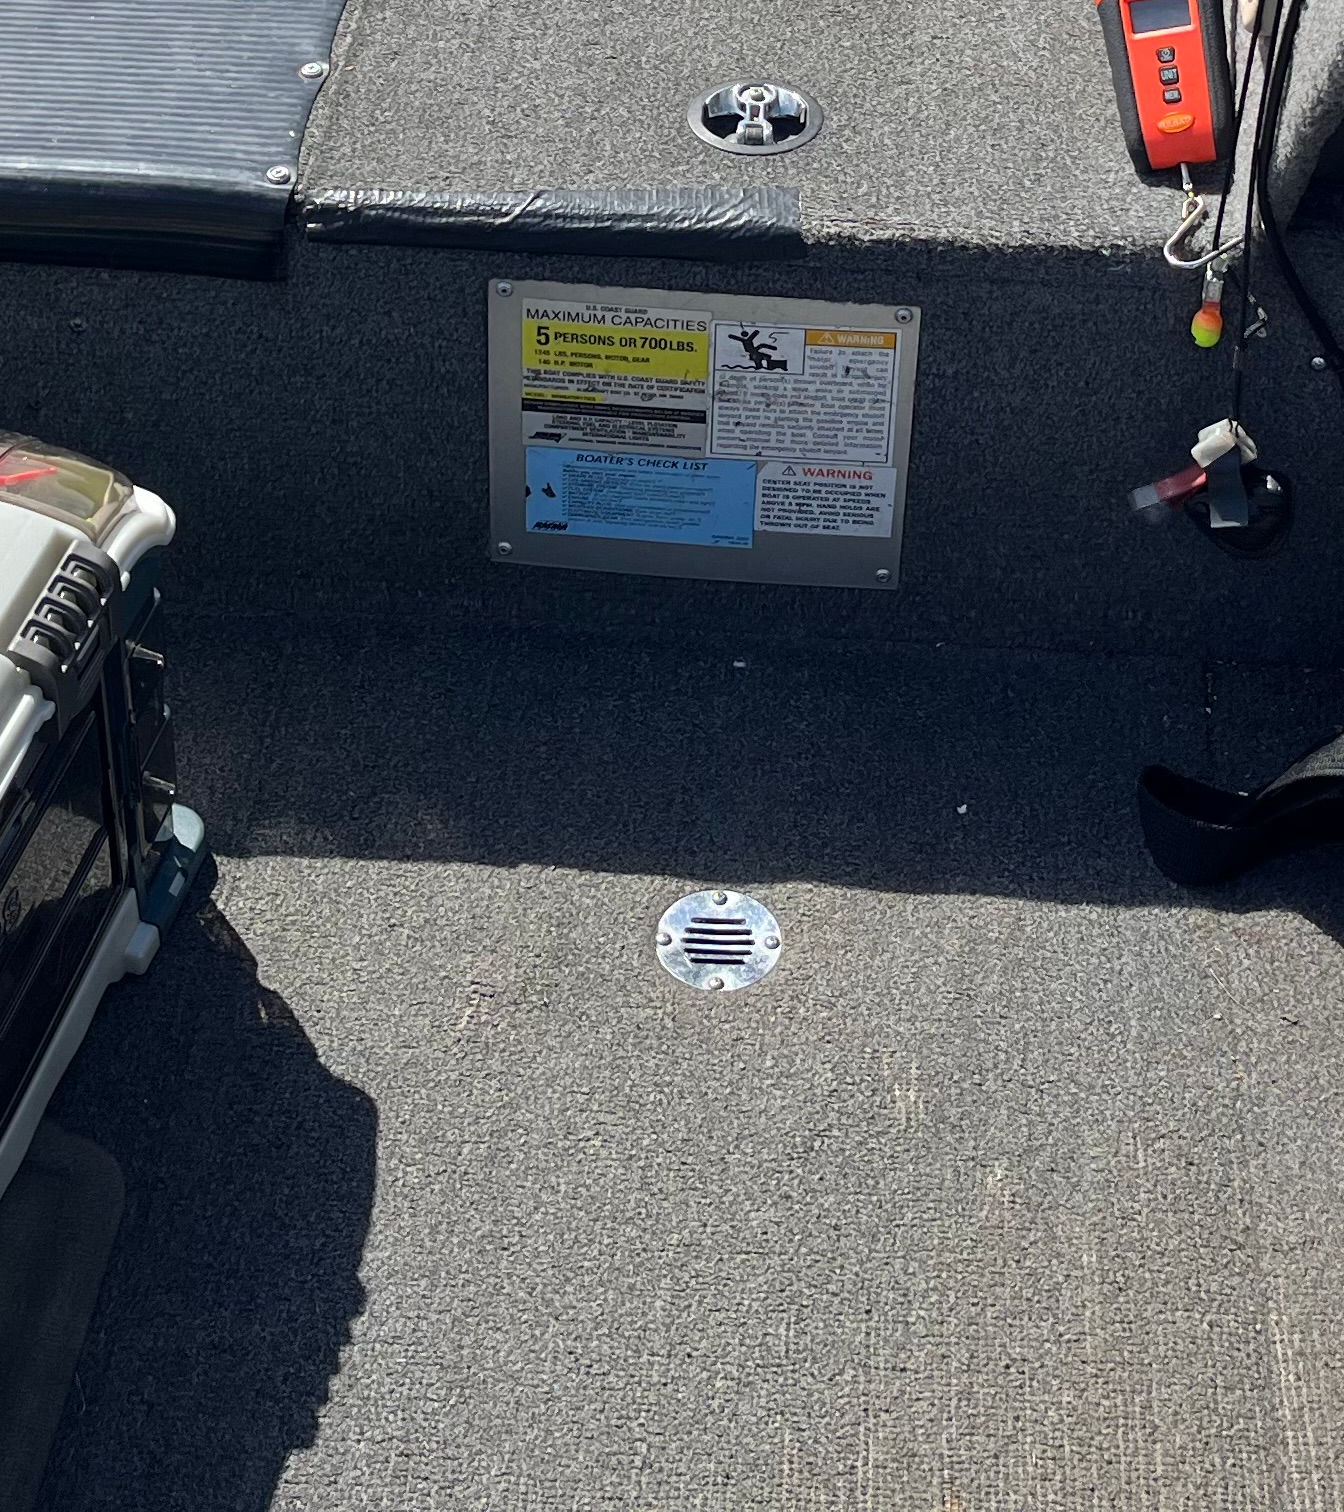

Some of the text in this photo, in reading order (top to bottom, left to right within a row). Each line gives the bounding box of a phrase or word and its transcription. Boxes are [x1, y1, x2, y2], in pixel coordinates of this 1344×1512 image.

[601, 305, 623, 313] COAST
[625, 307, 648, 315] GUARD
[526, 308, 707, 331] MAXIMUM CAPACITIES
[536, 326, 698, 352] 5 PERSONS OR 700 LBS.
[837, 334, 884, 345] WARNING
[576, 454, 709, 471] BOATER'S CHECK LIST
[802, 468, 873, 480] WARNING
